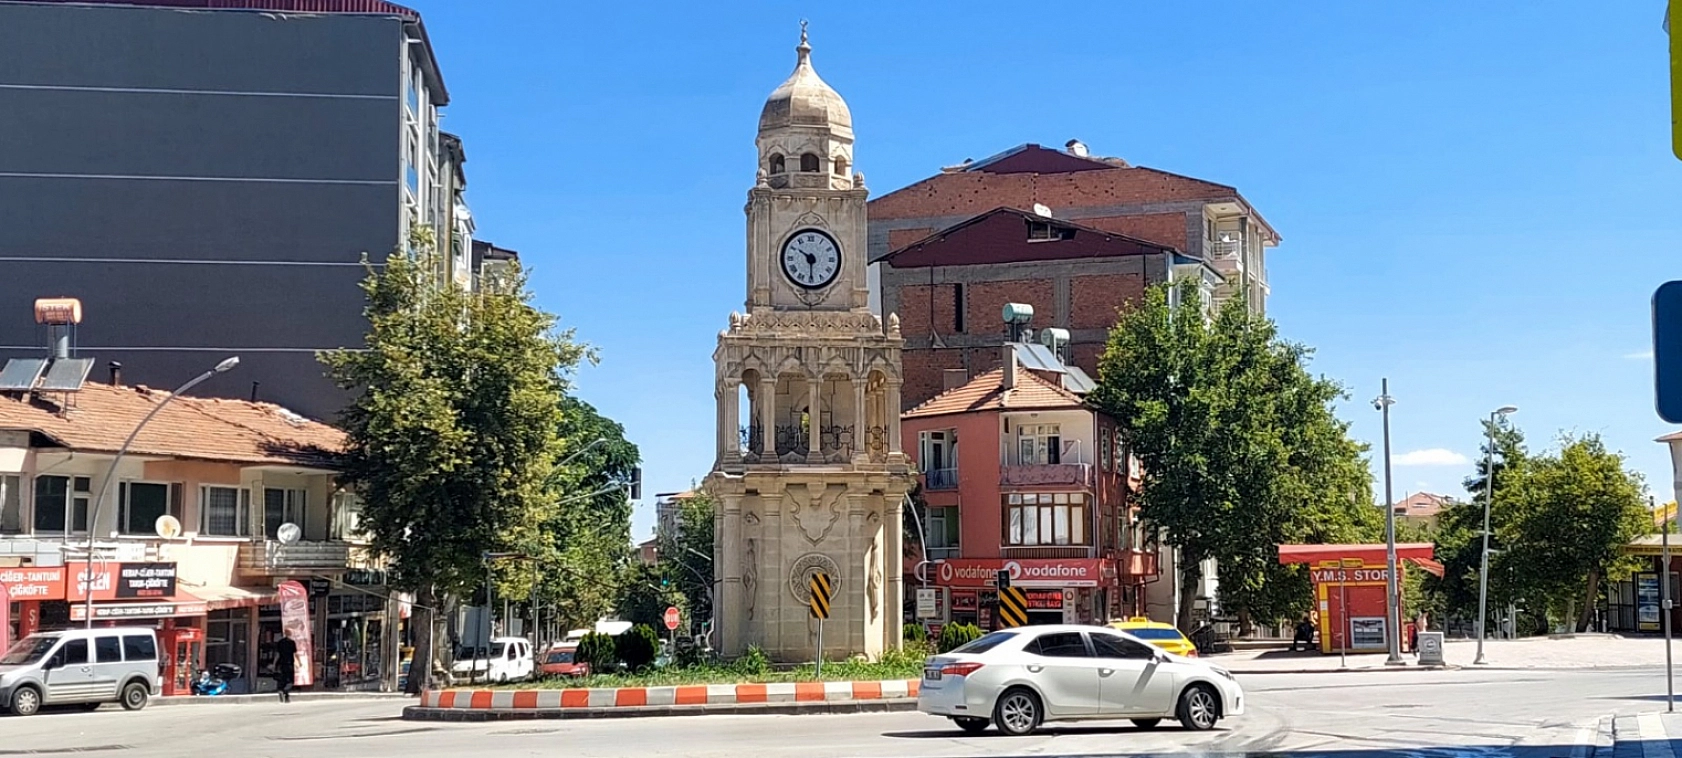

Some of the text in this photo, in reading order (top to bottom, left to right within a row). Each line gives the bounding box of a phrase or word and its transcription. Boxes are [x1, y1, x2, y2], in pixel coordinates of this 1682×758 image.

[954, 565, 998, 579] vodafone
[1024, 564, 1087, 577] vodafone
[1313, 570, 1351, 581] Y.M.S.
